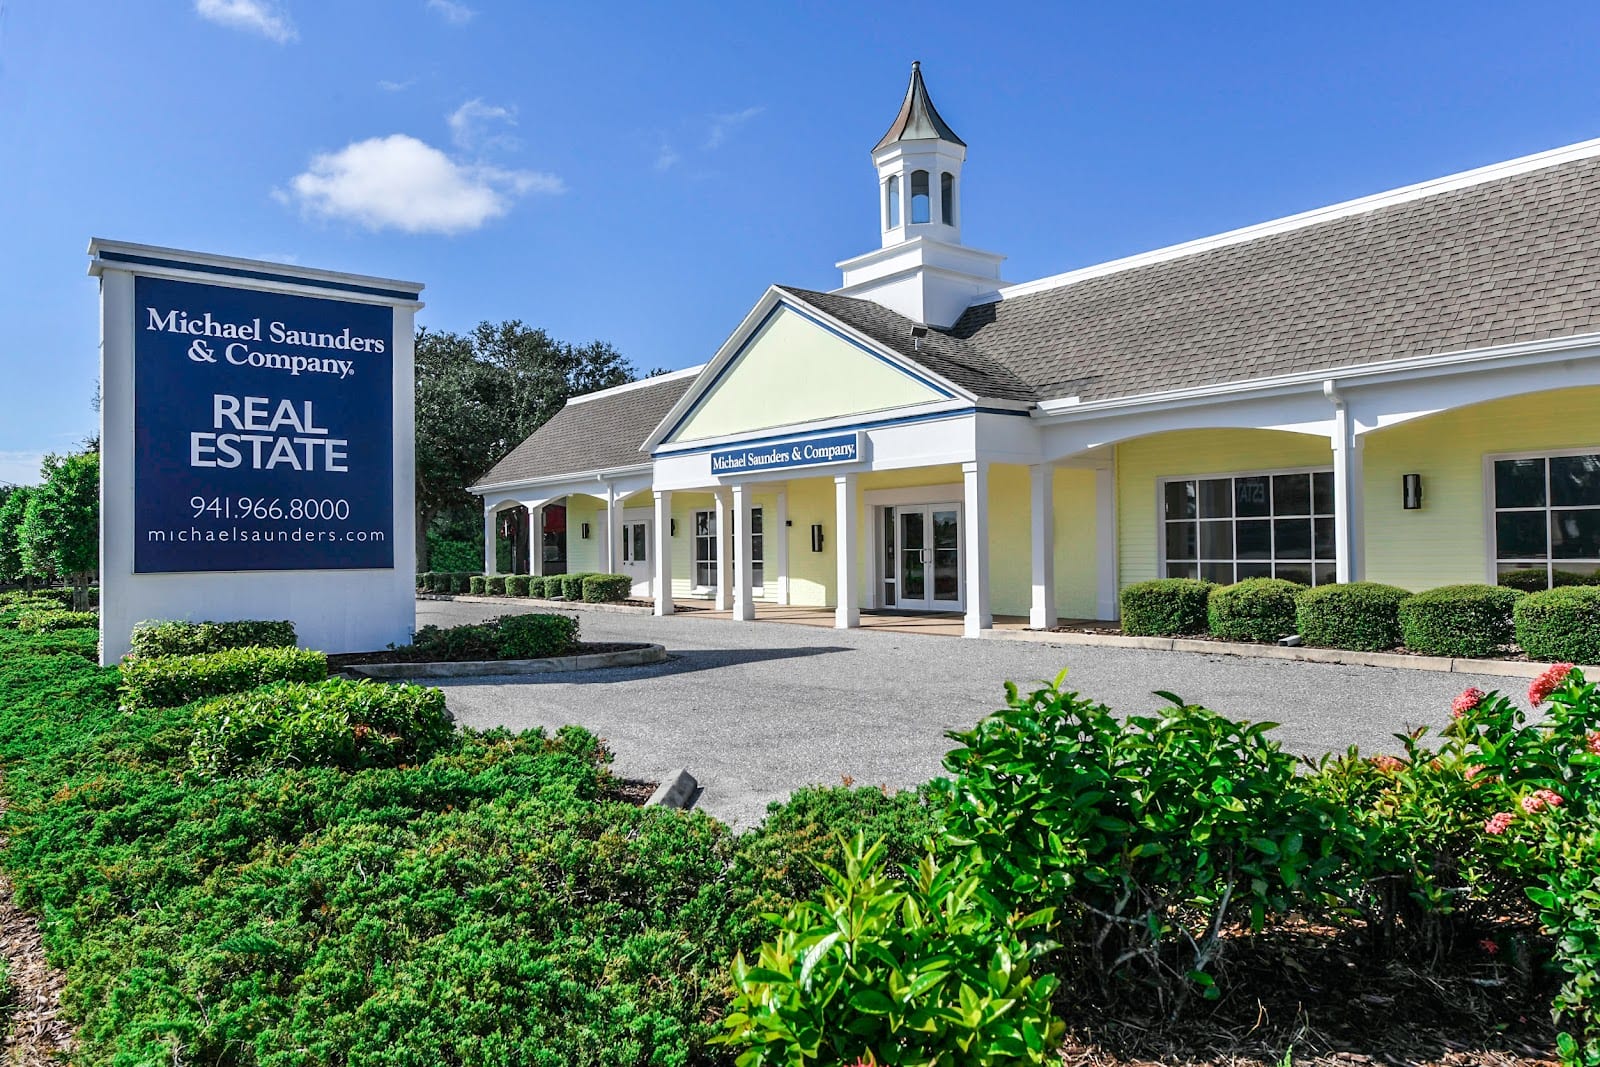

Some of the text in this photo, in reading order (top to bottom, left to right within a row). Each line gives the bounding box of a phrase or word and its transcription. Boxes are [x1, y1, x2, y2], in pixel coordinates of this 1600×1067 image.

[146, 307, 385, 354] Michael Saunders
[187, 339, 218, 363] &
[213, 394, 329, 435] REAL
[190, 431, 348, 472] ESTATE
[712, 453, 747, 470] Michael
[747, 449, 790, 466] Saunders
[791, 446, 802, 460] &
[190, 496, 350, 520] 941.966.8000
[148, 526, 385, 542] michaelsaunders.com
